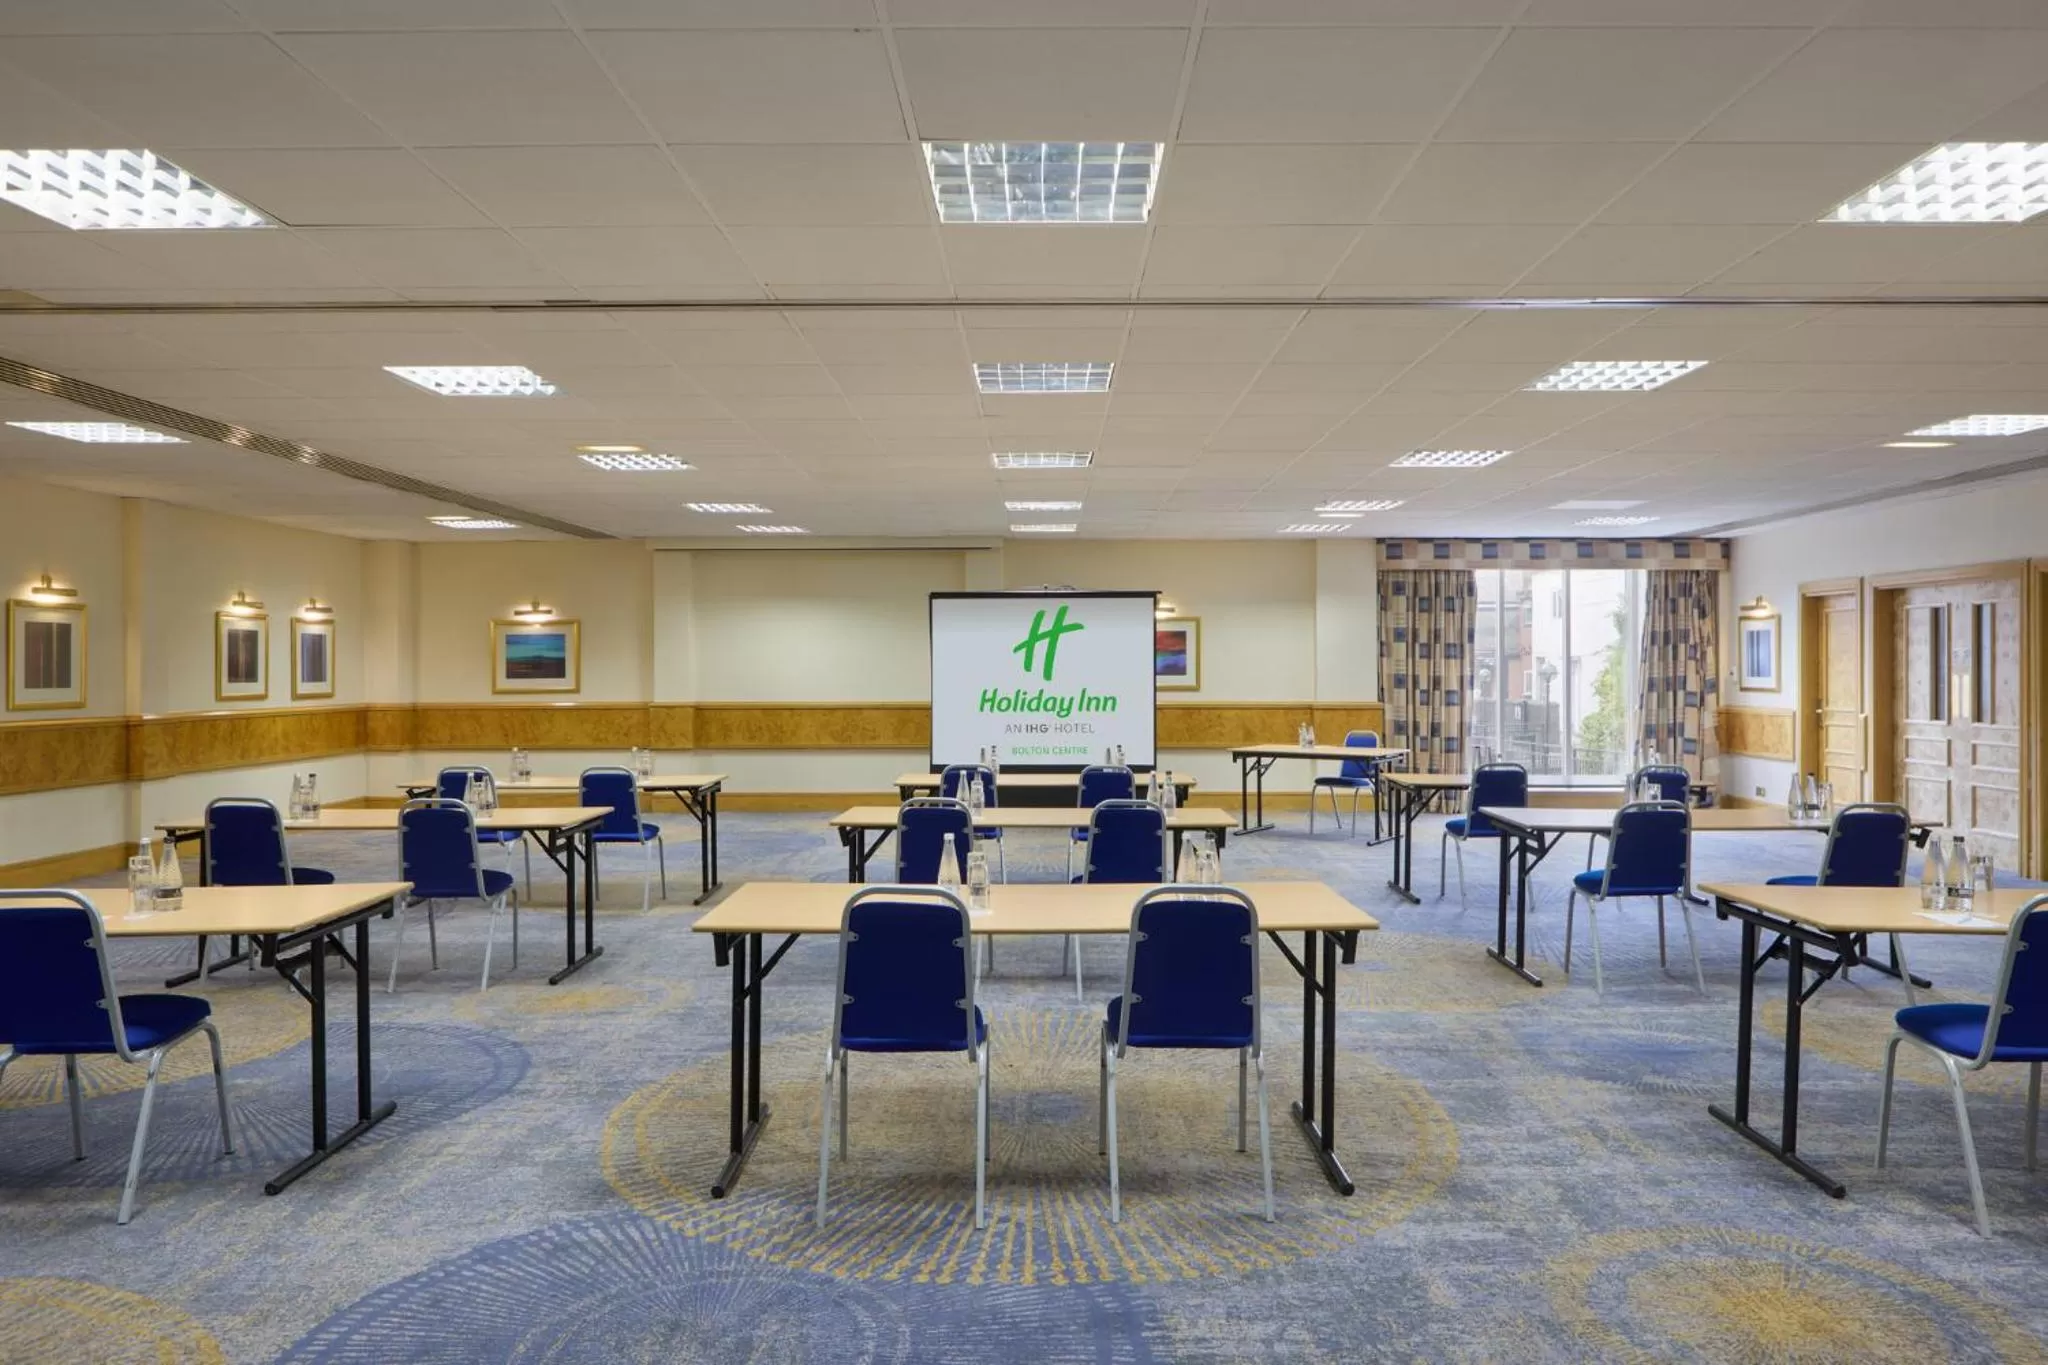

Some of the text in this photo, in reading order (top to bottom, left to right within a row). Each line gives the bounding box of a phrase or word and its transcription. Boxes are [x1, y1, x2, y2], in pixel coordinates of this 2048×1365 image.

[979, 688, 1117, 718] Holiday Inn
[1004, 724, 1022, 734] AN
[1054, 723, 1095, 734] HOTEL
[1012, 746, 1088, 755] BOLTON CENTRE
